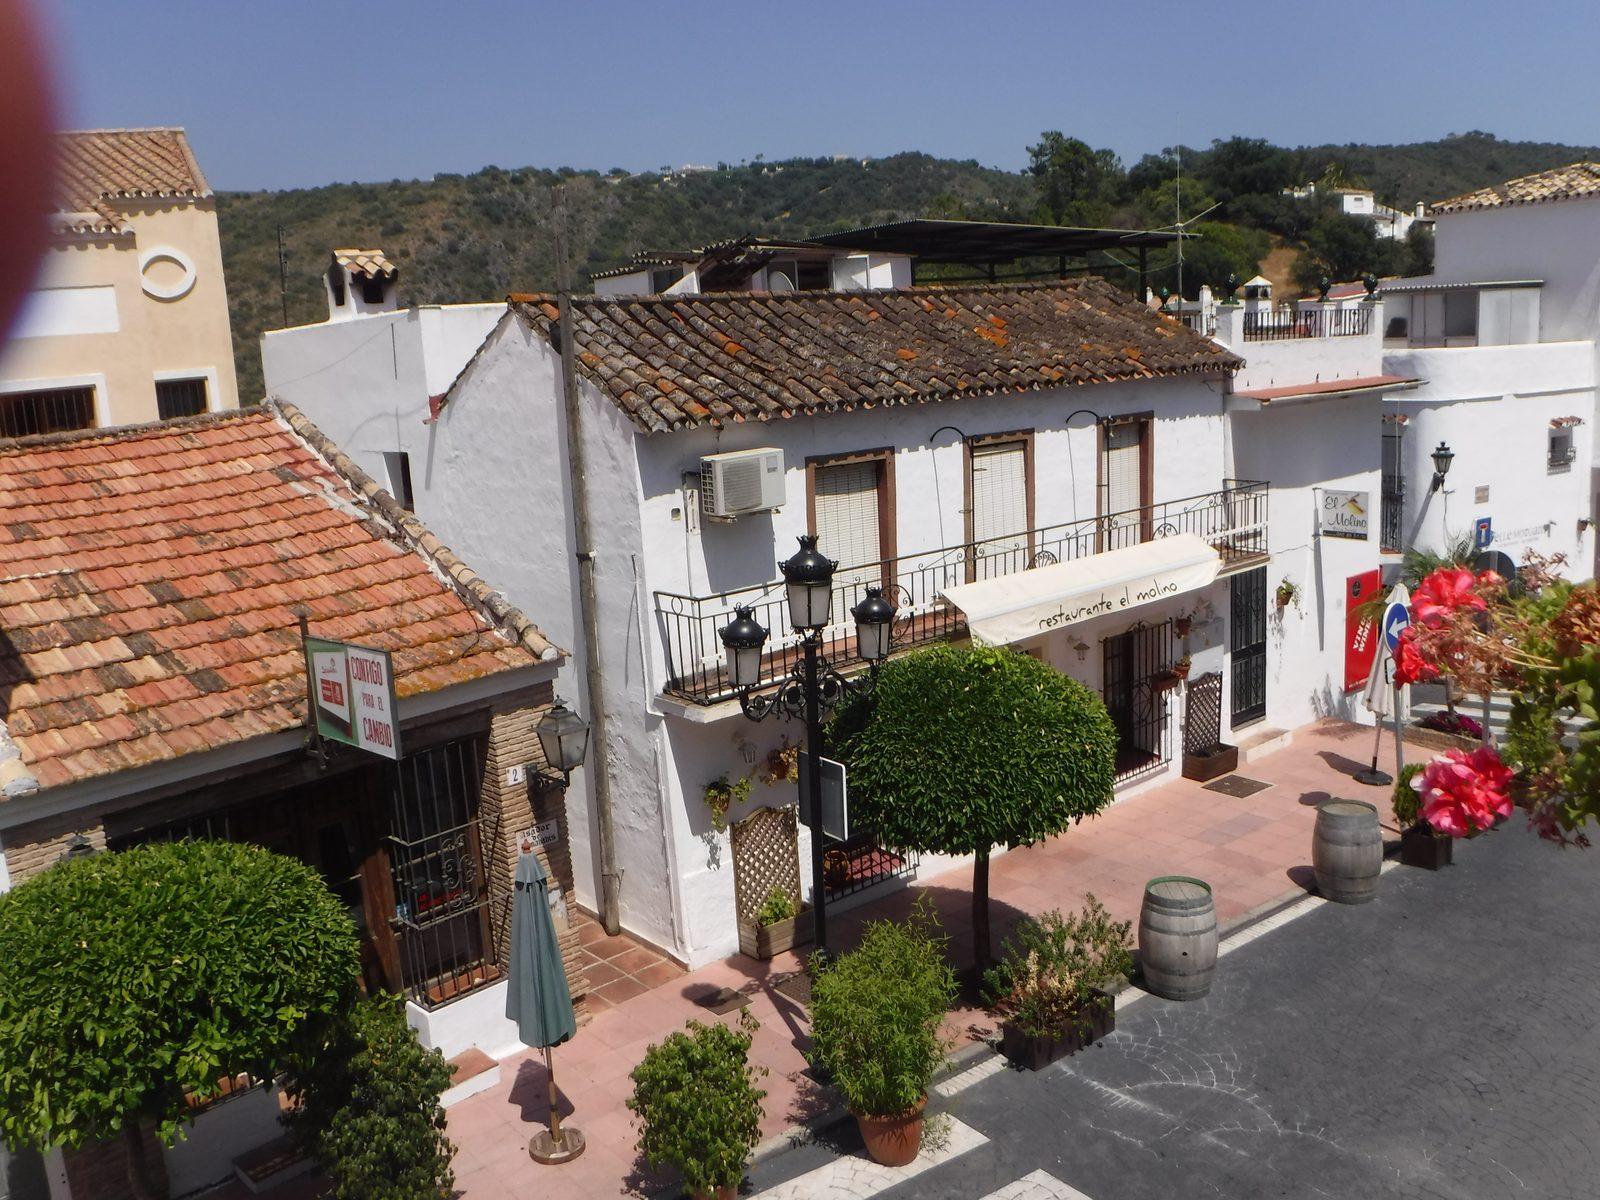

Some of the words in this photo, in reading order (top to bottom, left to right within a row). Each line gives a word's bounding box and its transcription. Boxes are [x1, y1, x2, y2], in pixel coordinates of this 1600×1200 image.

[1324, 496, 1338, 510] El
[1327, 513, 1367, 528] Molino
[1039, 593, 1112, 629] restaurante
[1120, 585, 1130, 606] el
[1136, 578, 1178, 601] molino
[351, 657, 382, 686] CONTIGO
[362, 692, 375, 708] PARA
[378, 697, 384, 711] EL
[363, 717, 392, 747] CAMBIO
[512, 769, 518, 782] 2
